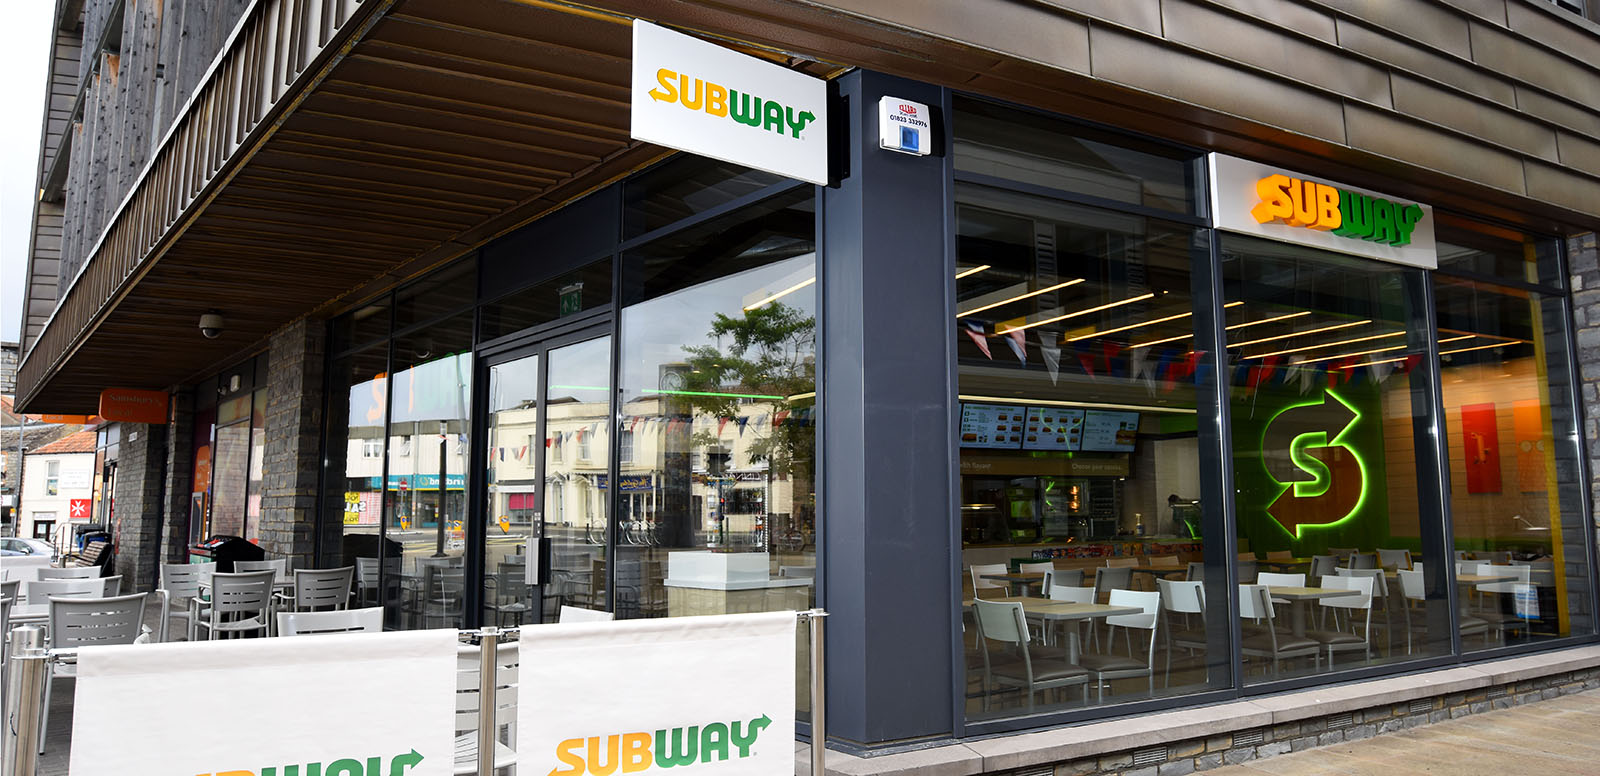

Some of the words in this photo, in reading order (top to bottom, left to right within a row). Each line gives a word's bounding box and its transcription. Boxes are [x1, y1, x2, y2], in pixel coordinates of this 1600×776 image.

[648, 68, 817, 139] SUBWAY
[1251, 173, 1425, 248] SUBWAY
[547, 713, 773, 776] SUBWAY
